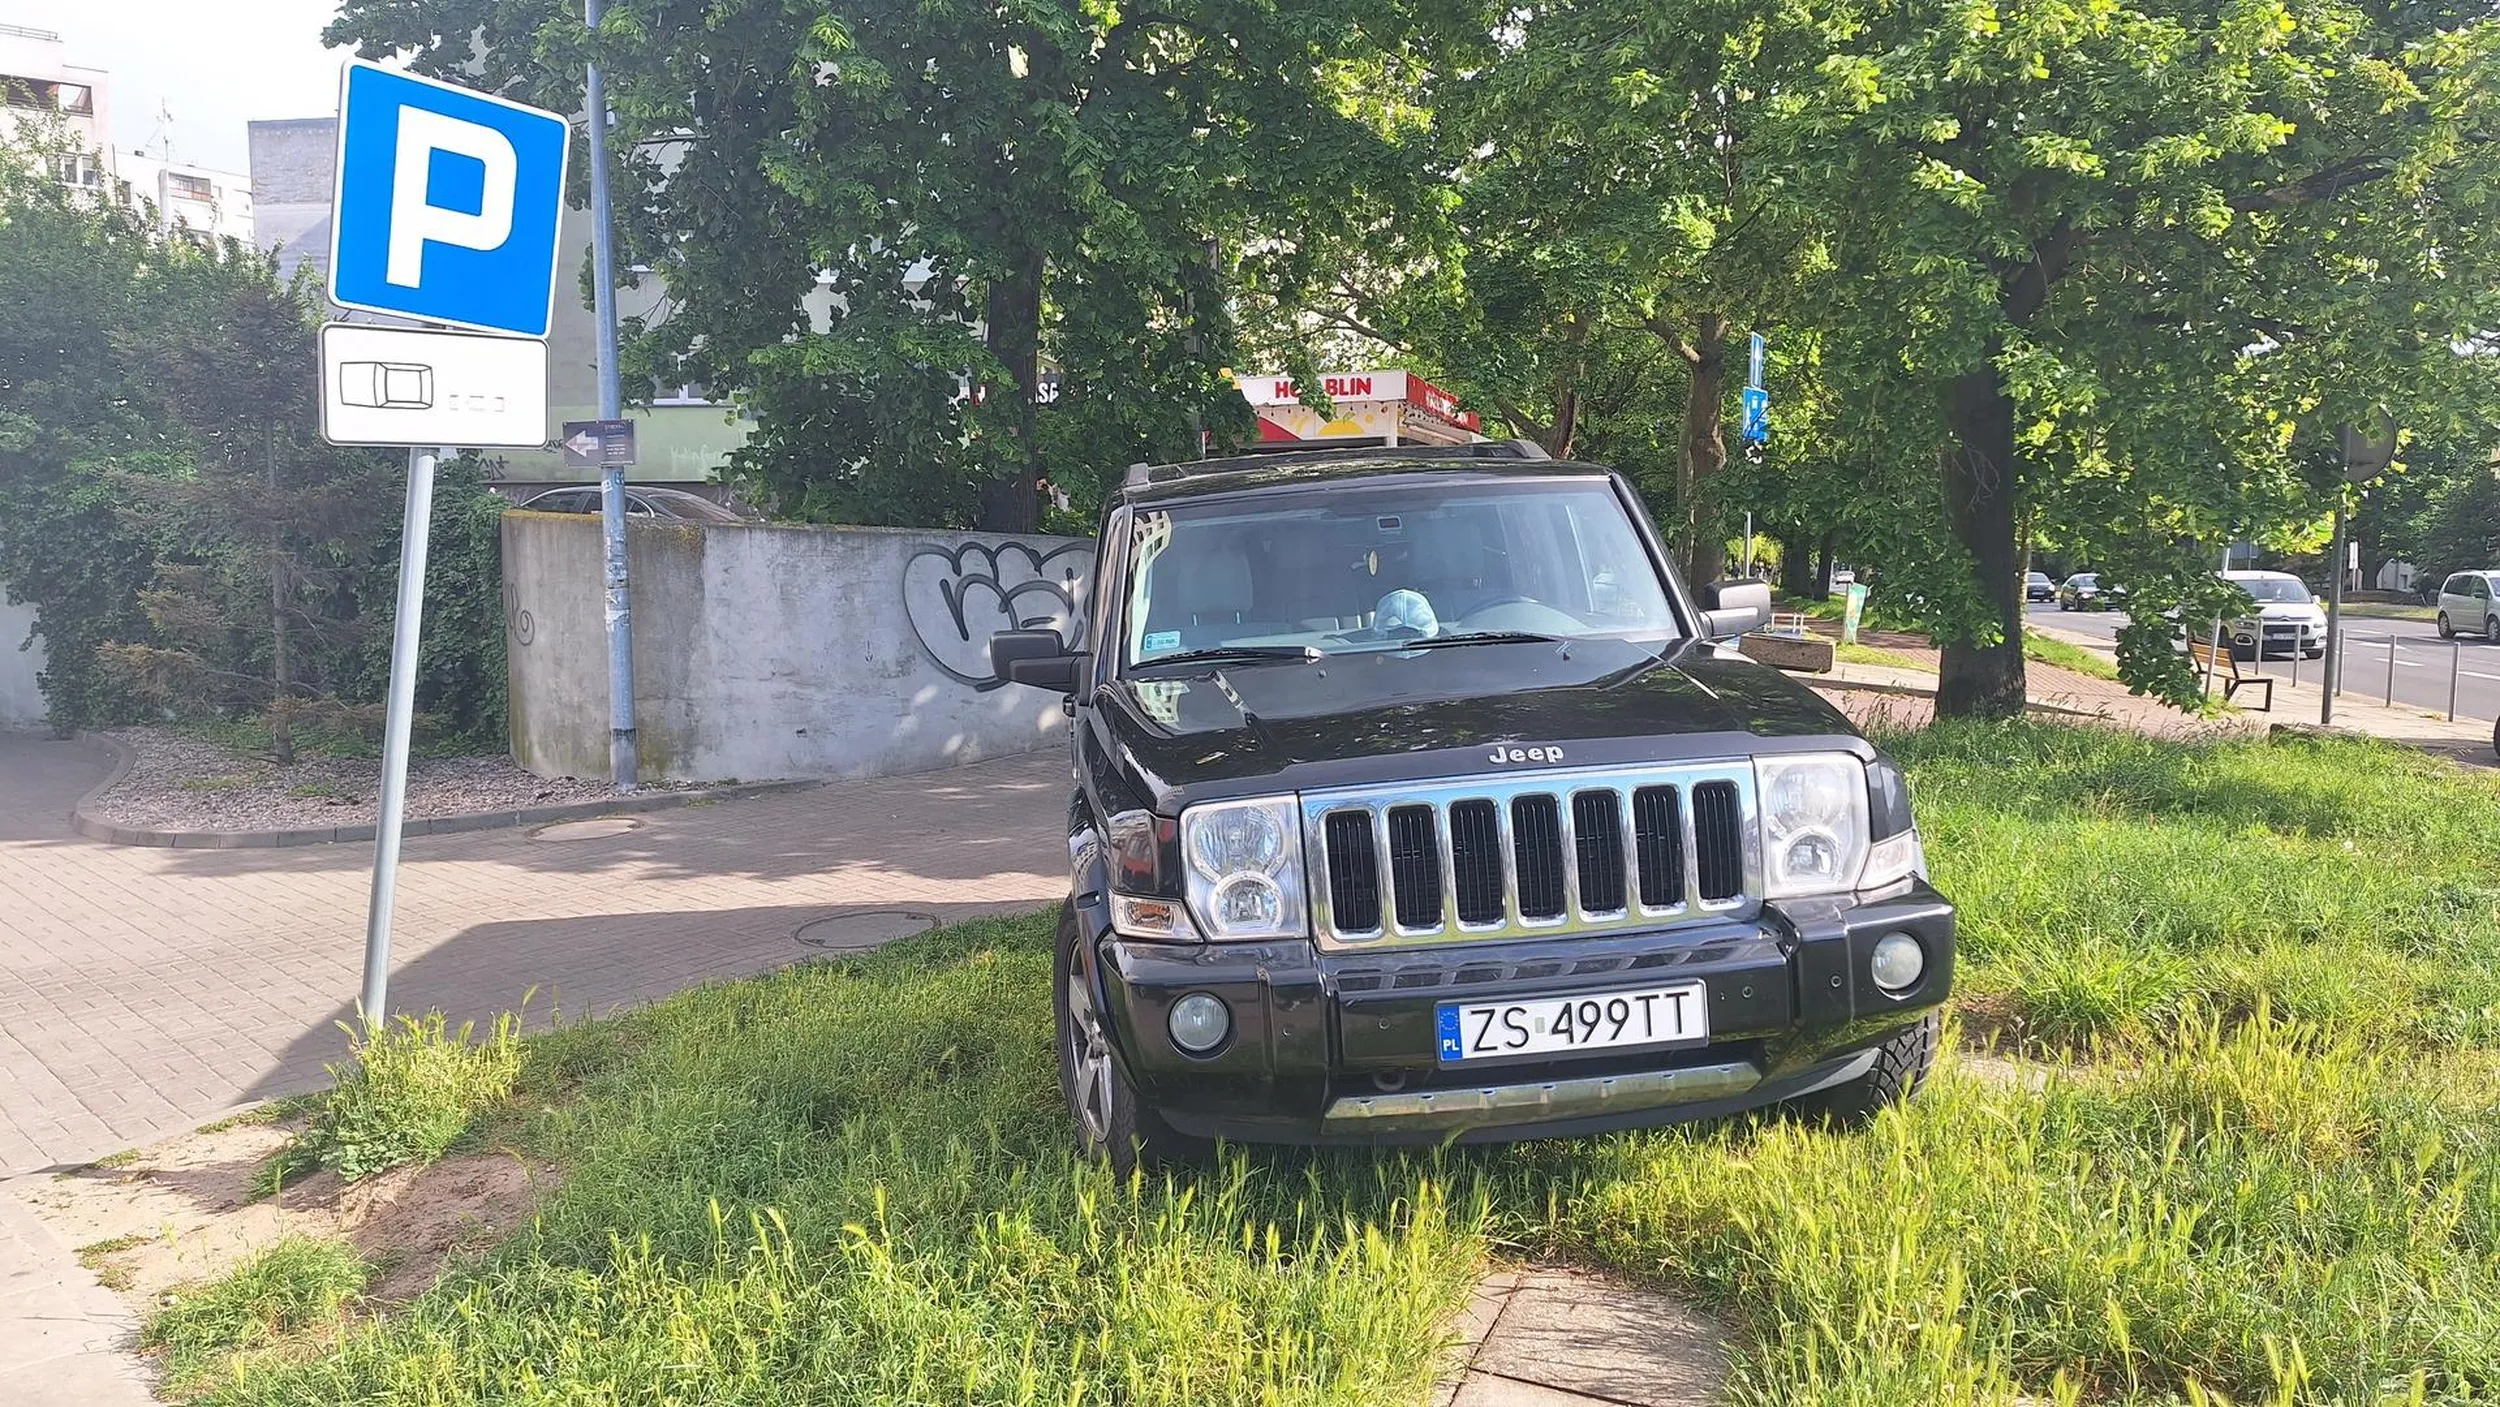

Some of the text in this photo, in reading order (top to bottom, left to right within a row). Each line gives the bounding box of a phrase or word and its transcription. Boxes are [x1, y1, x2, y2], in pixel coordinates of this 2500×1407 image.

[386, 104, 518, 289] P
[1325, 377, 1371, 396] BLIN
[1488, 745, 1564, 764] Jeep
[1442, 991, 1691, 1052] PL ZS 499TT
